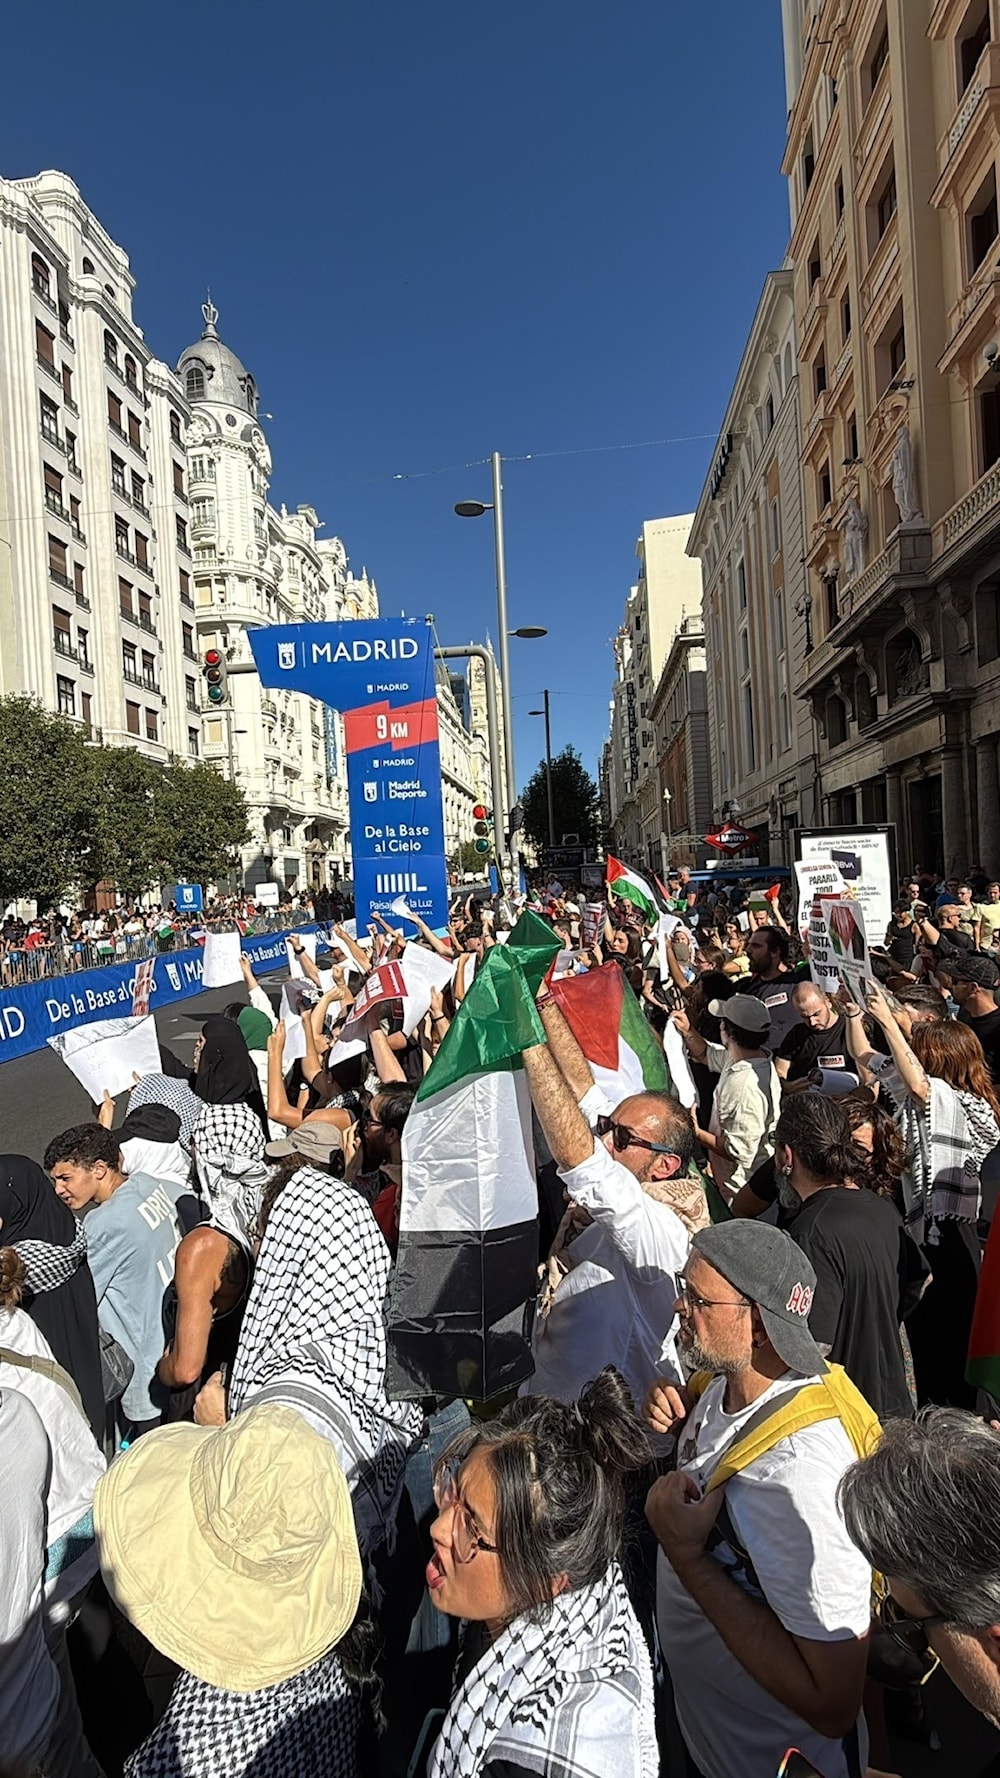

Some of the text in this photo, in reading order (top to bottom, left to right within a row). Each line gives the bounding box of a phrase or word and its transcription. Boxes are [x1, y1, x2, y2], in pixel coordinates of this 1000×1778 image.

[312, 638, 418, 663] MADRID
[377, 683, 409, 692] MADRID
[376, 714, 408, 739] 9 KM
[382, 759, 415, 767] MADRID
[388, 780, 420, 790] Madrid
[388, 789, 427, 800] Deporte
[365, 824, 429, 839] De la Base
[720, 834, 744, 843] Metro
[374, 839, 422, 853] al Cielo
[809, 873, 838, 885] PARARLO
[369, 900, 392, 911] Paisaj
[410, 899, 417, 908] la
[418, 899, 433, 908] Luz
[258, 946, 274, 960] Base
[45, 999, 71, 1023] De
[71, 993, 86, 1015] la
[85, 989, 117, 1012] Base
[117, 981, 129, 1001] al
